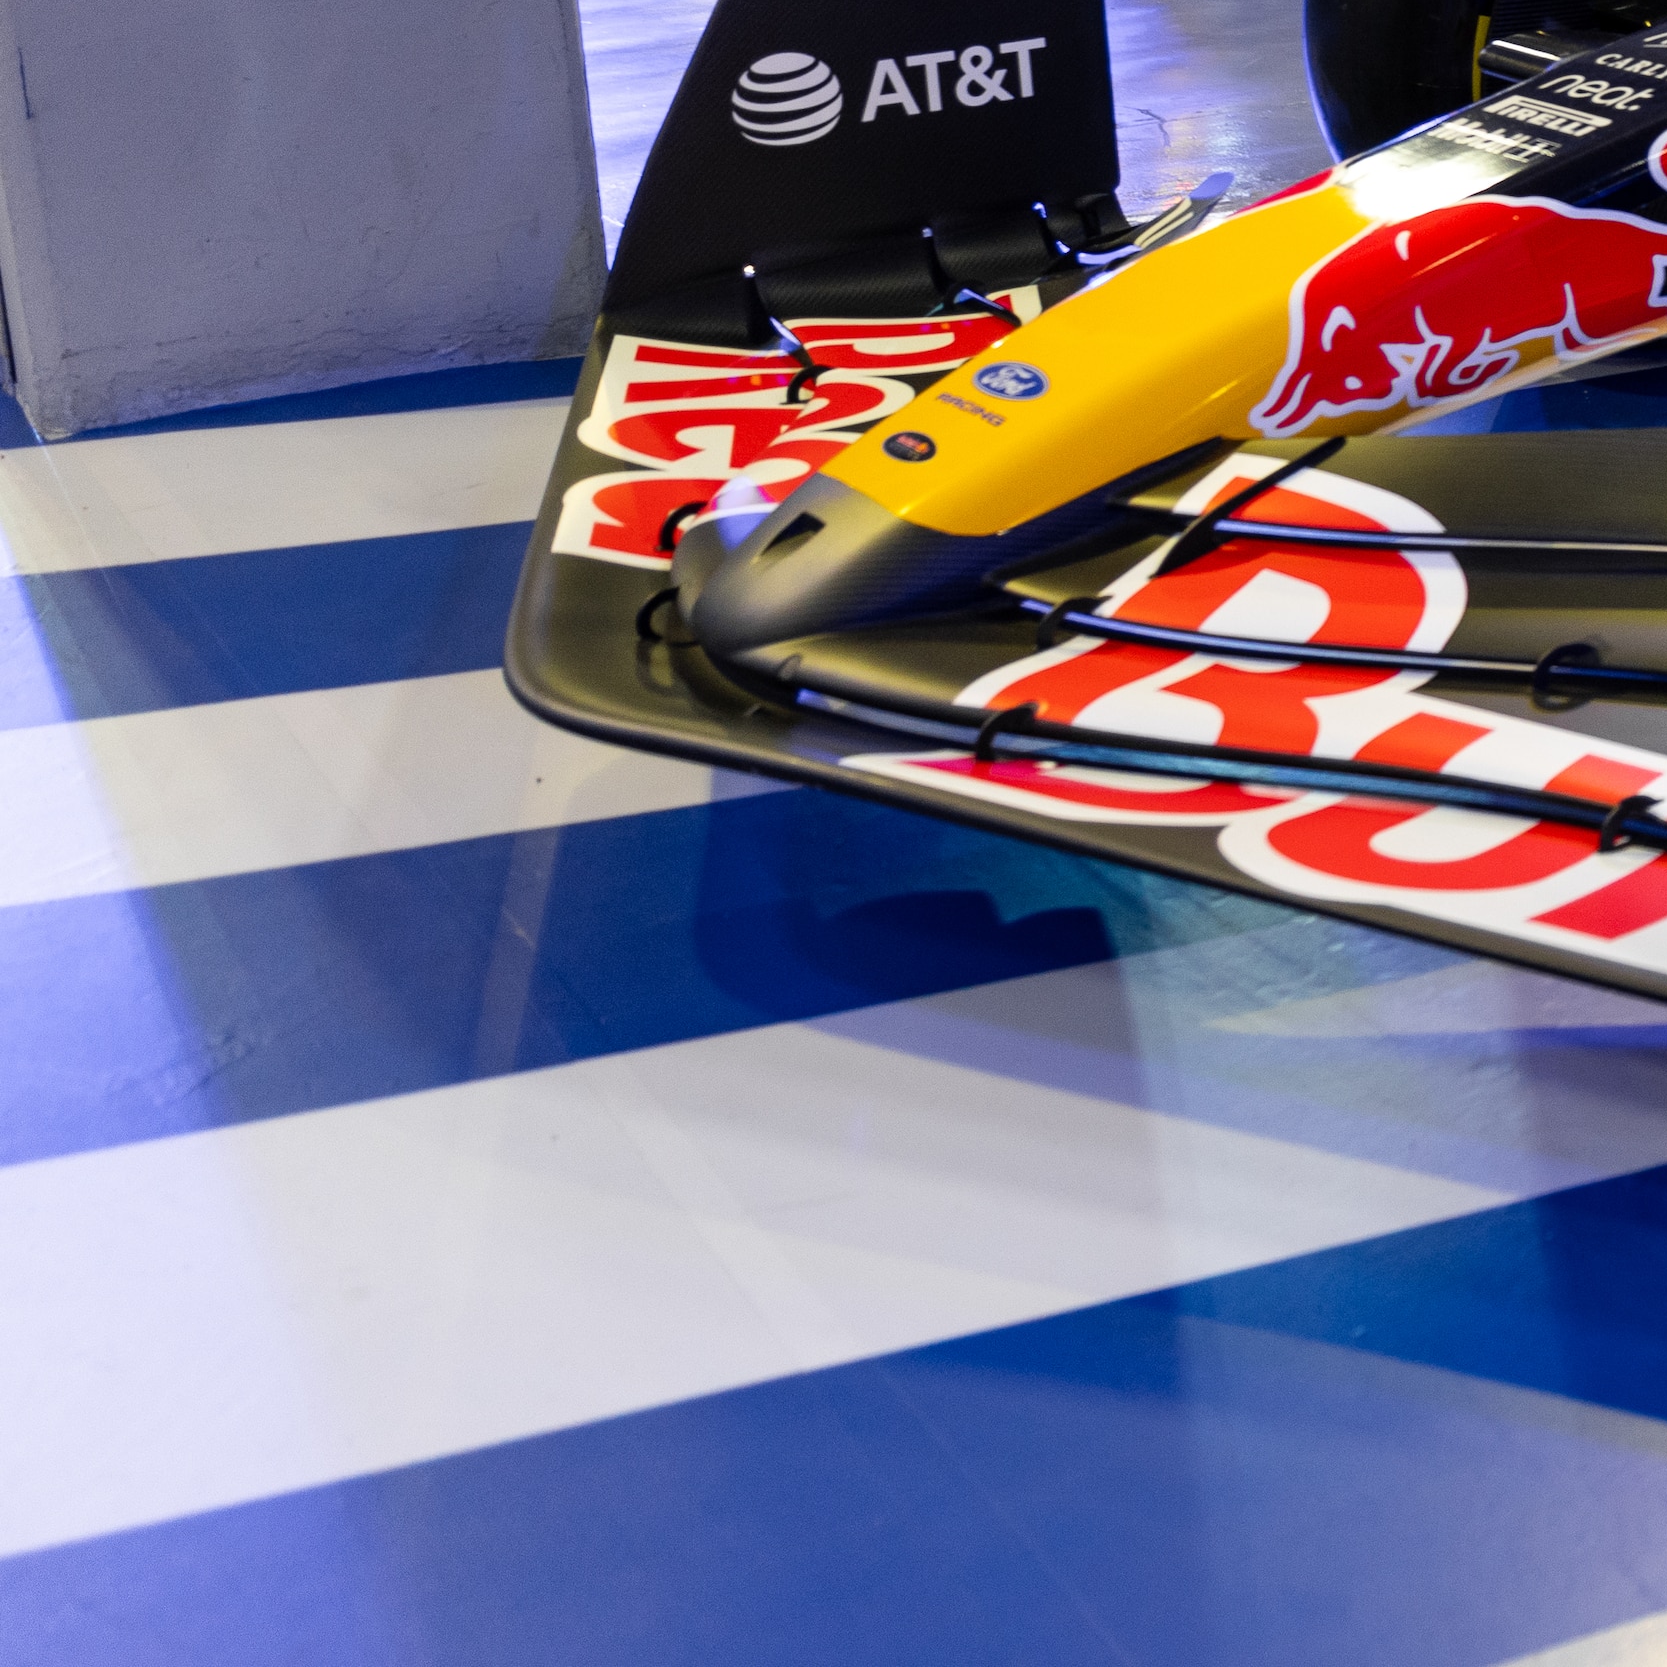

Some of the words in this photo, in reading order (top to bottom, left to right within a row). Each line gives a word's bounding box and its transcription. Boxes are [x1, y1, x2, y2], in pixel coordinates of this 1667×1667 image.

[861, 37, 1046, 123] AT&T
[1483, 94, 1613, 137] PIRELLI
[979, 364, 1039, 396] Ford
[937, 392, 1006, 427] RACING
